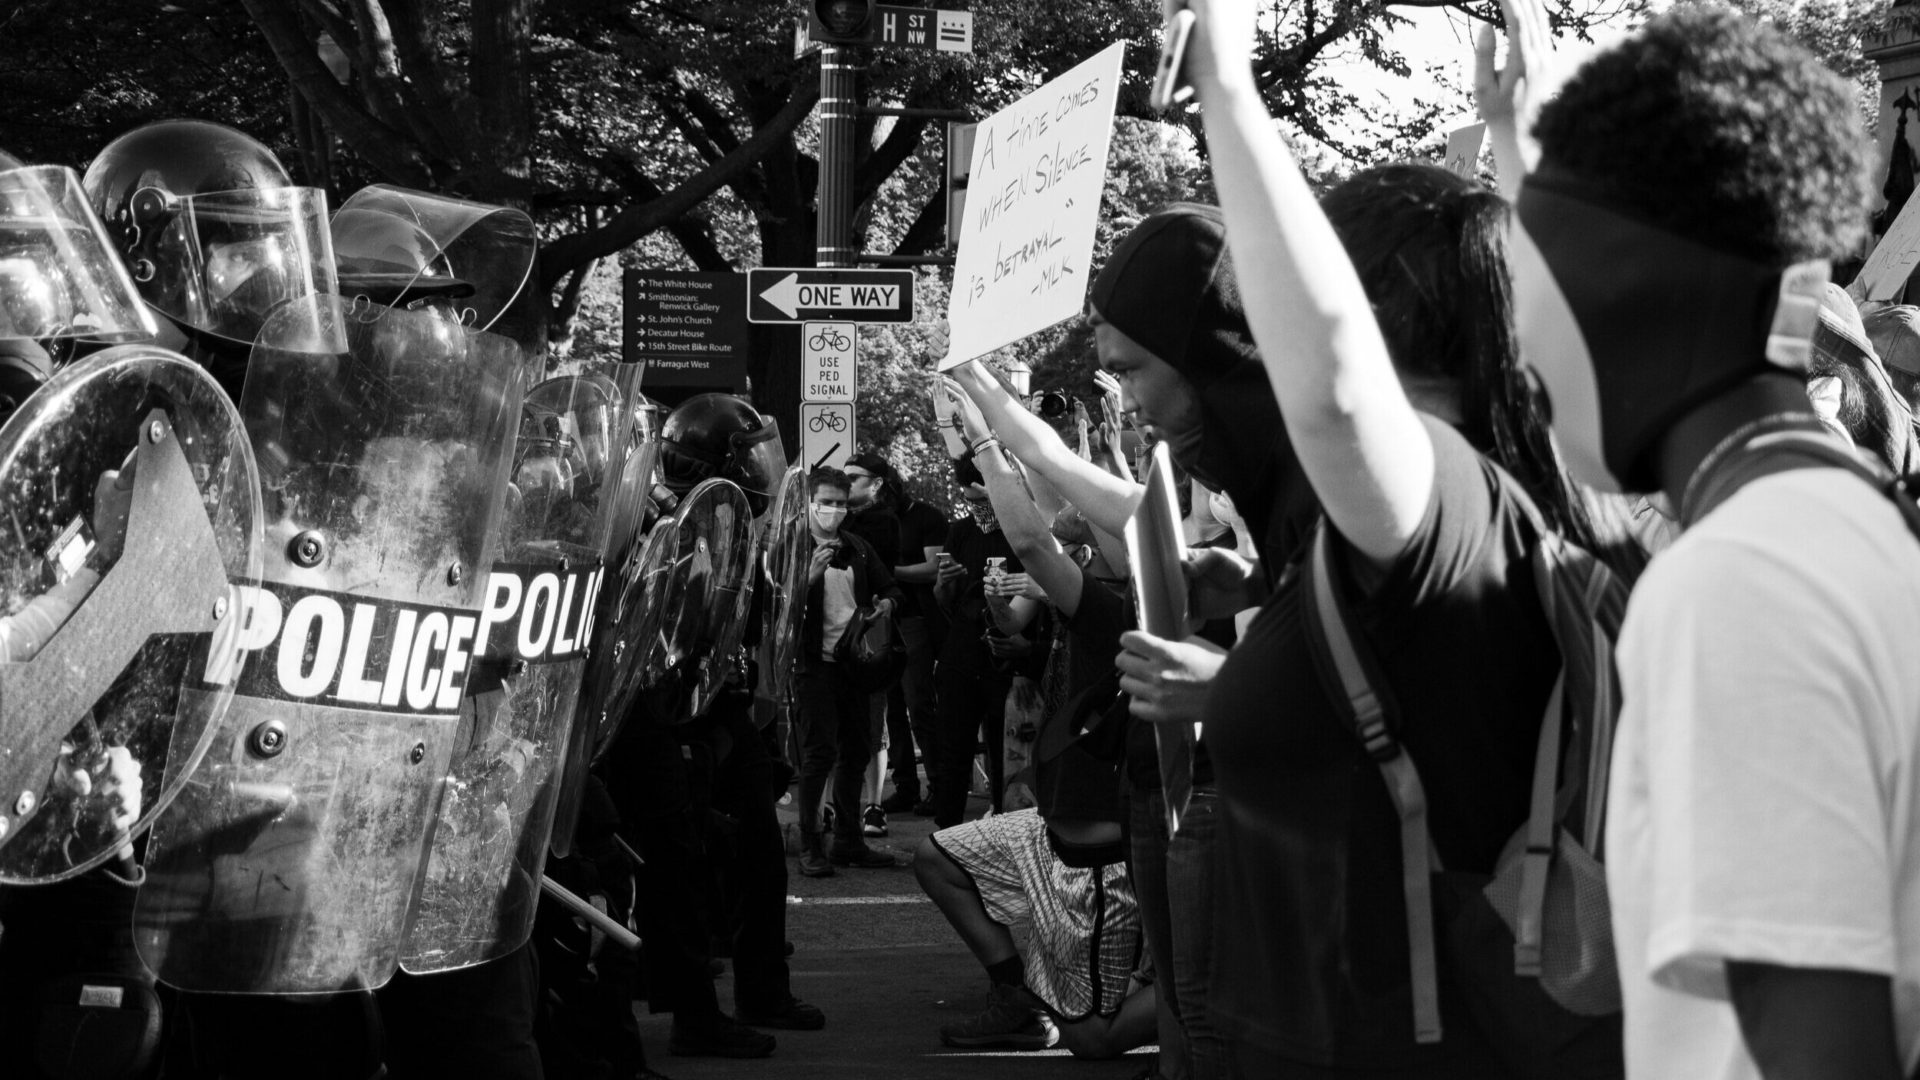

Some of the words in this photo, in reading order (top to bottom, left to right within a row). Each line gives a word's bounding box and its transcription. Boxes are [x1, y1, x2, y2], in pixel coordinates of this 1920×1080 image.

[883, 12, 897, 43] H
[908, 14, 926, 28] ST
[907, 30, 926, 44] NW
[977, 126, 995, 180] A
[1055, 77, 1100, 122] COMES
[979, 168, 1031, 233] WHEN
[647, 279, 663, 288] The
[664, 279, 687, 289] White
[688, 280, 713, 290] House
[648, 292, 699, 302] Smithsonian:
[798, 286, 842, 306] ONE
[850, 287, 896, 307] WAY
[659, 301, 692, 310] Renwick
[692, 302, 721, 313] Gallery
[647, 314, 658, 323] St.
[659, 315, 683, 324] John's
[684, 316, 713, 325] Church
[647, 328, 679, 337] Decatur
[680, 329, 705, 338] House
[648, 342, 666, 351] 15th
[667, 342, 690, 351] Street
[691, 343, 708, 352] Bike
[709, 343, 732, 352] Route
[656, 360, 690, 370] Farragut
[690, 360, 710, 369] West
[819, 356, 840, 368] USE
[819, 371, 840, 382] PED
[810, 384, 848, 396] SIGNAL
[473, 565, 605, 659] POLIC
[203, 583, 476, 711] POLICE
